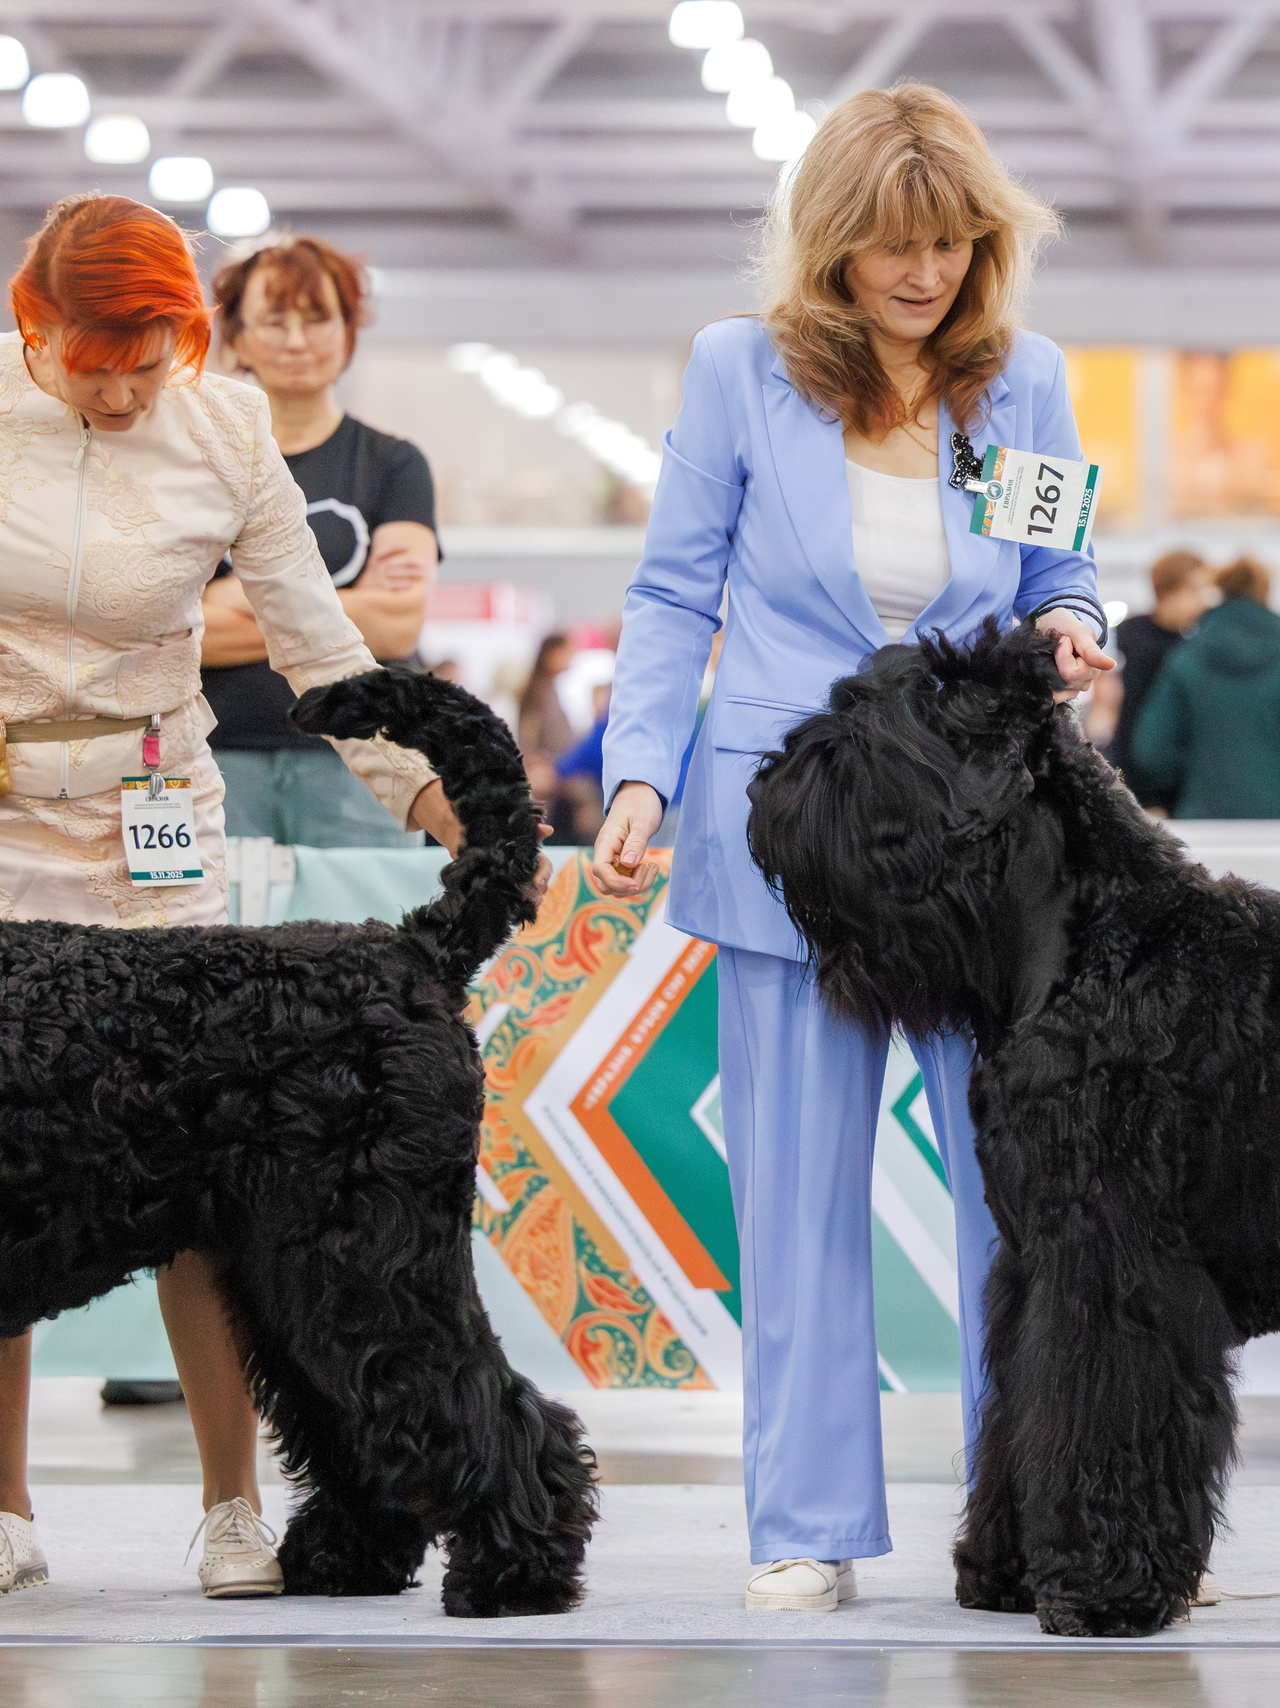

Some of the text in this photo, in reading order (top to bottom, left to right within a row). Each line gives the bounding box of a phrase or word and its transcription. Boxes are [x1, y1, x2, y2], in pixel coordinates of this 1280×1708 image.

[1003, 479, 1014, 509] ЕВРАЗИЯ
[1027, 462, 1065, 536] 1267
[1078, 488, 1093, 528] 15.11.2025
[128, 822, 191, 850] 1266
[149, 870, 184, 880] 15.11.2025
